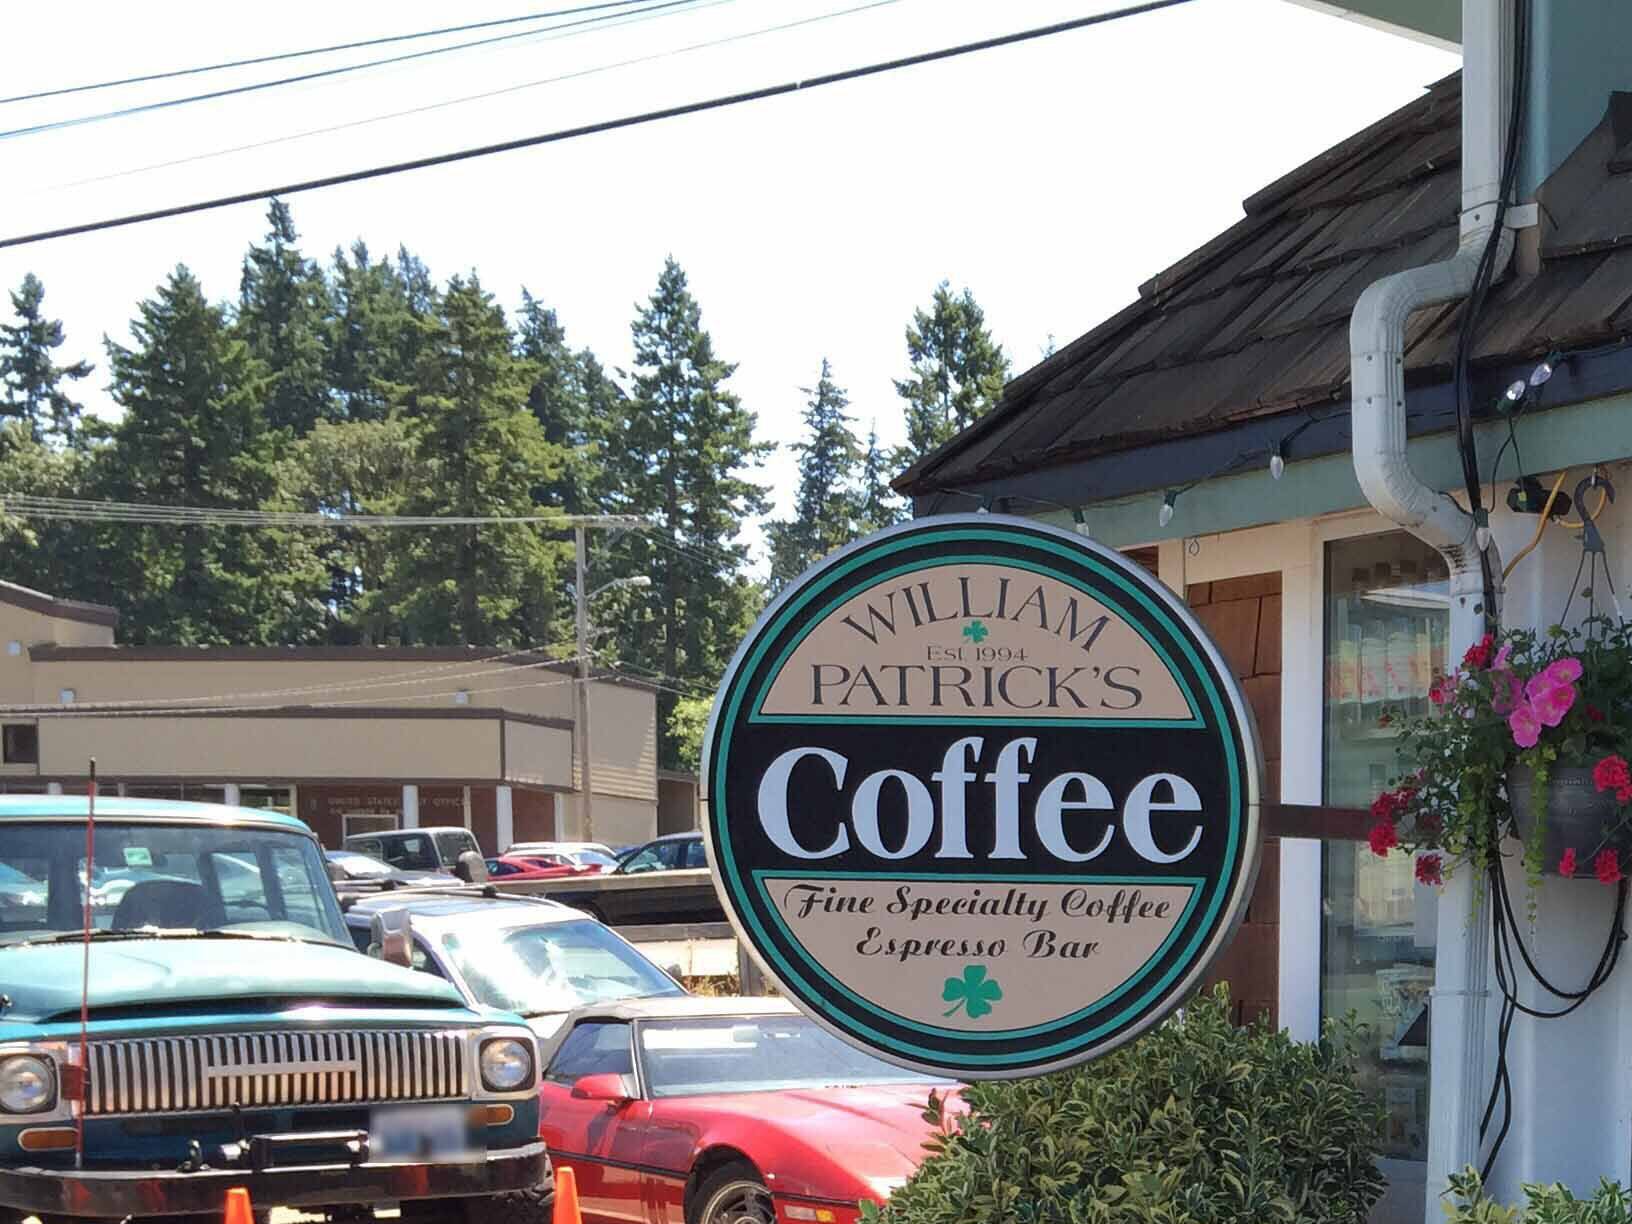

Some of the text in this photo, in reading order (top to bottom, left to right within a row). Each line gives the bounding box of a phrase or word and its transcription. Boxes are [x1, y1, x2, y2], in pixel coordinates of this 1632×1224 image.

[841, 577, 1110, 652] WILLIAM
[975, 646, 1029, 661] 1994
[810, 664, 1143, 710] PATRICK'S
[757, 736, 1203, 864] Coffee
[783, 884, 1171, 925] Fine Specialty Coffee
[856, 926, 1100, 962] Espresso Bar
